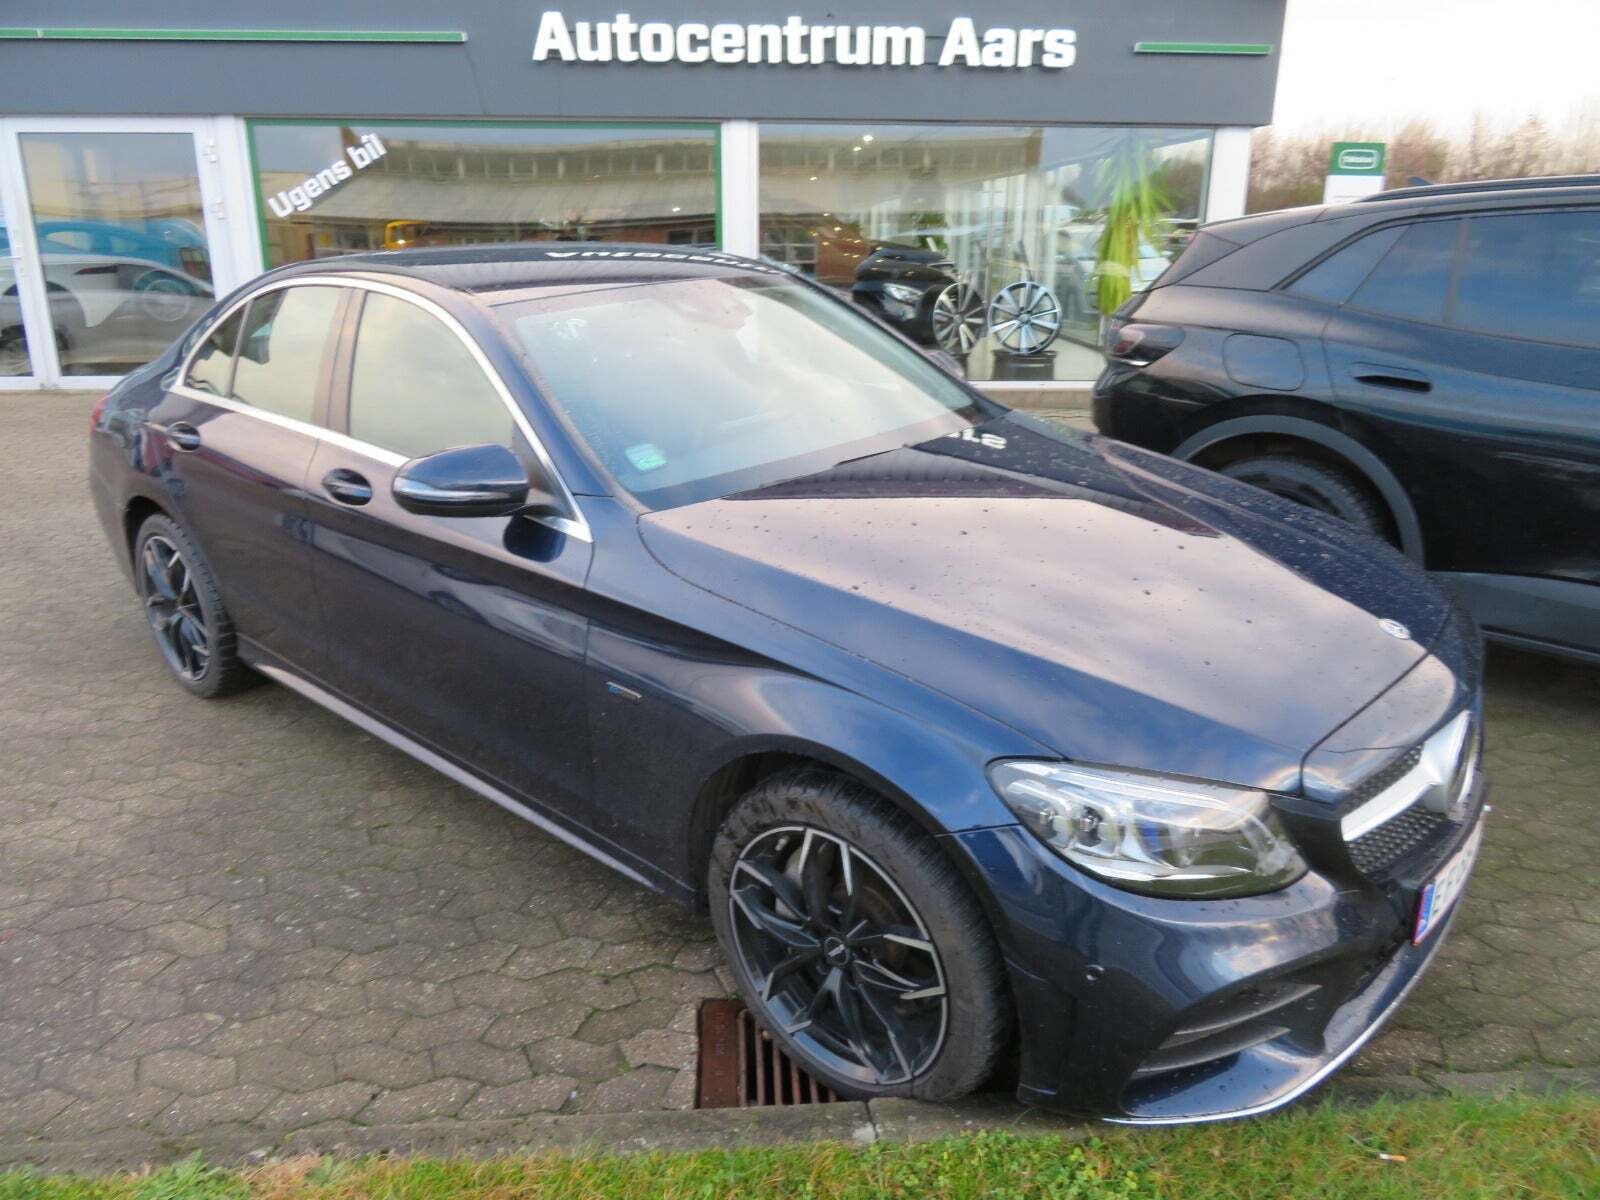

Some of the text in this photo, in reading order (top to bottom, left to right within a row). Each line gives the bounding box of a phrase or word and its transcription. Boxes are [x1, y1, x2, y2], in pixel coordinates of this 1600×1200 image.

[533, 11, 1077, 68] Autocentrum Aars
[267, 132, 388, 218] Ugens bil
